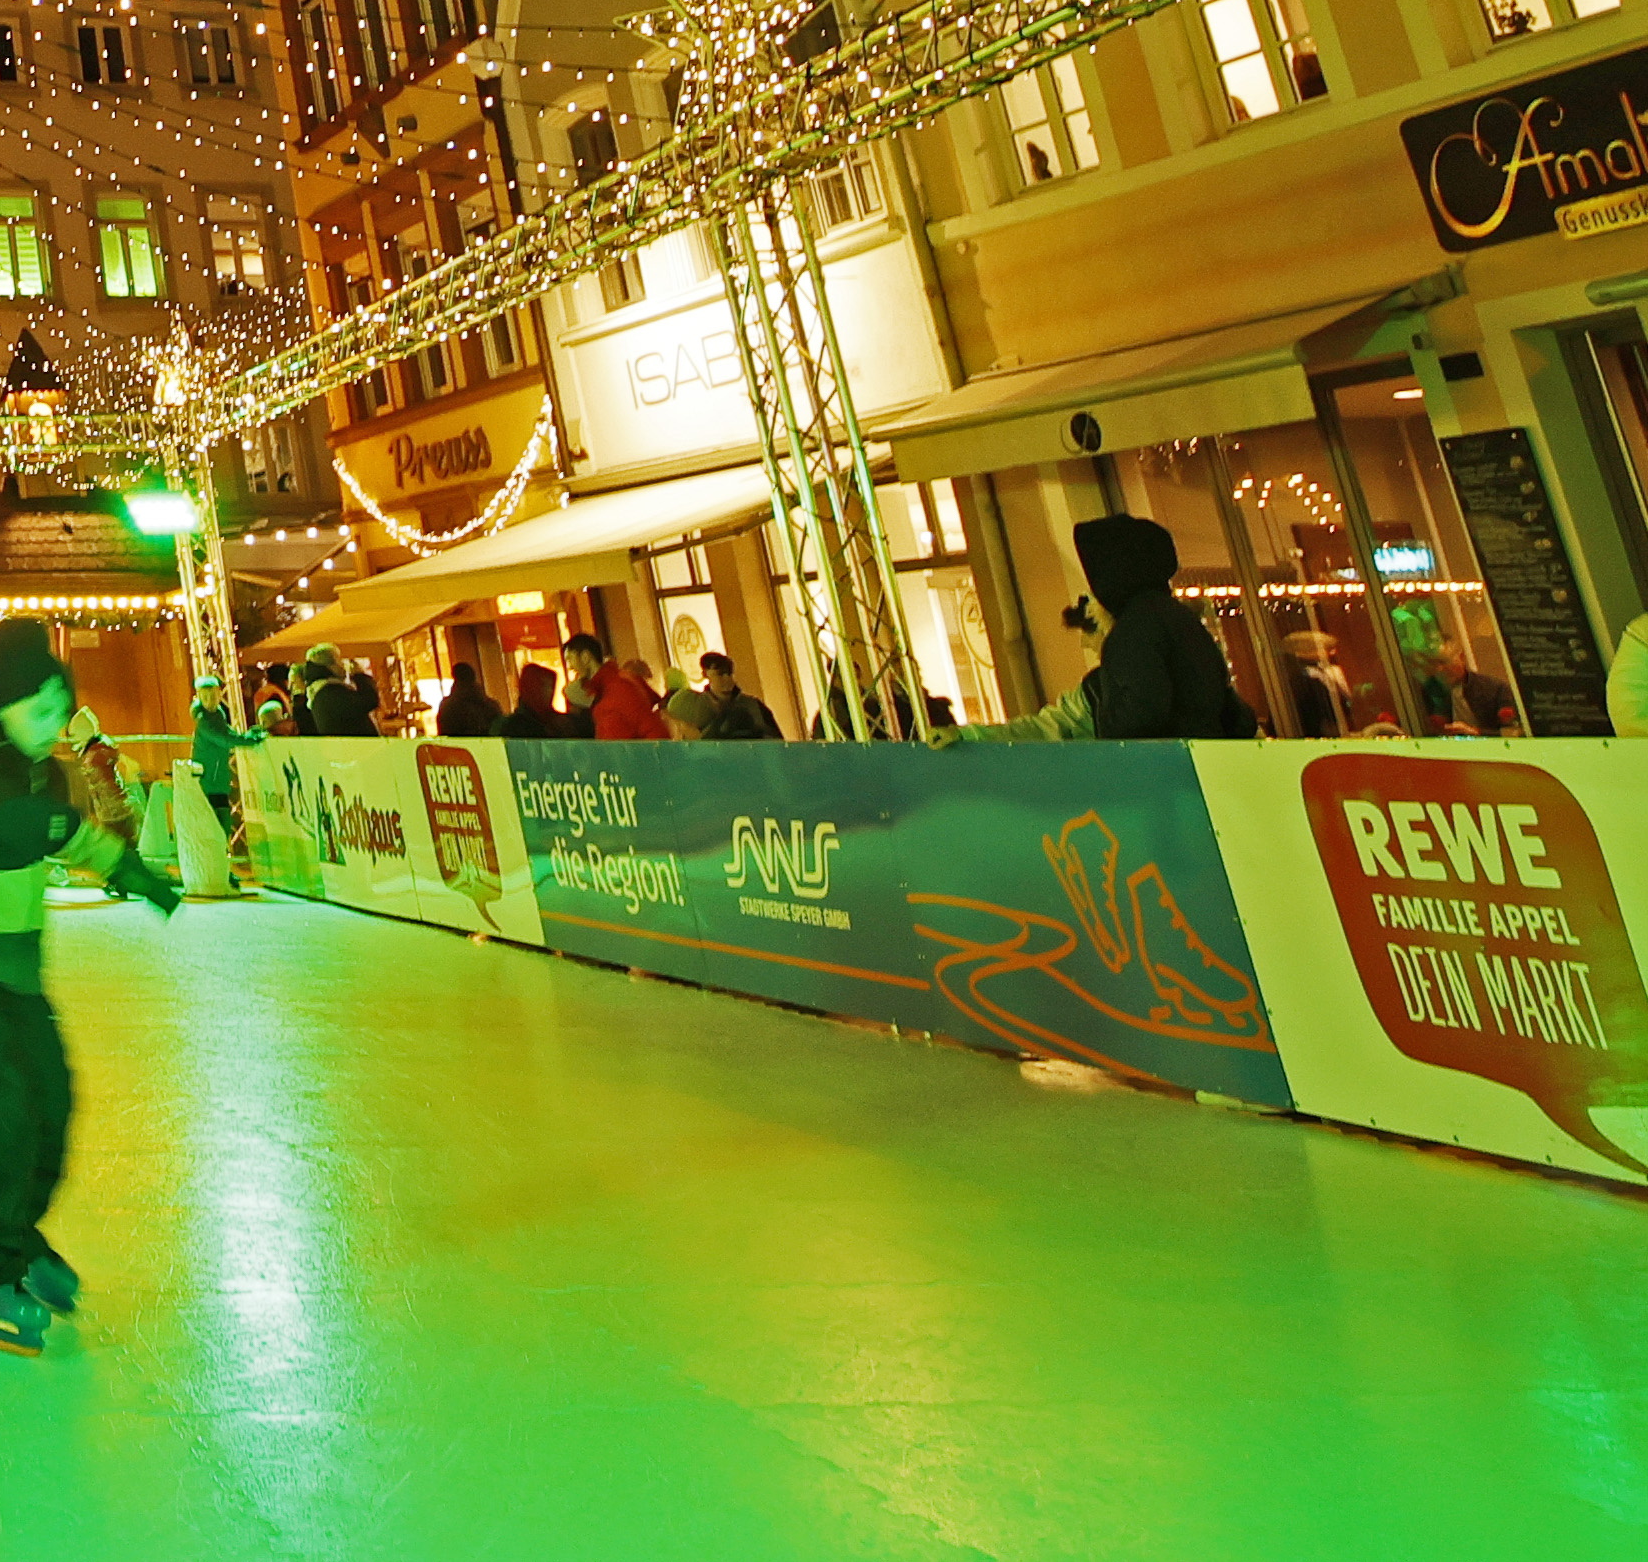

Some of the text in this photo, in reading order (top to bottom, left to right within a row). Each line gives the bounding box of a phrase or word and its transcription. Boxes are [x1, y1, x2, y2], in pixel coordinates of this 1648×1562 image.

[388, 426, 492, 489] Preuss
[425, 765, 477, 806] REWE
[515, 770, 639, 839] Energie für
[550, 836, 686, 915] die Region!
[1342, 798, 1563, 890] REWE
[739, 895, 791, 922] STADTWERKE
[790, 903, 824, 927] SPEYER
[1371, 891, 1581, 947] FAMILIE APPEL
[1385, 942, 1610, 1051] DEIN MARKT
